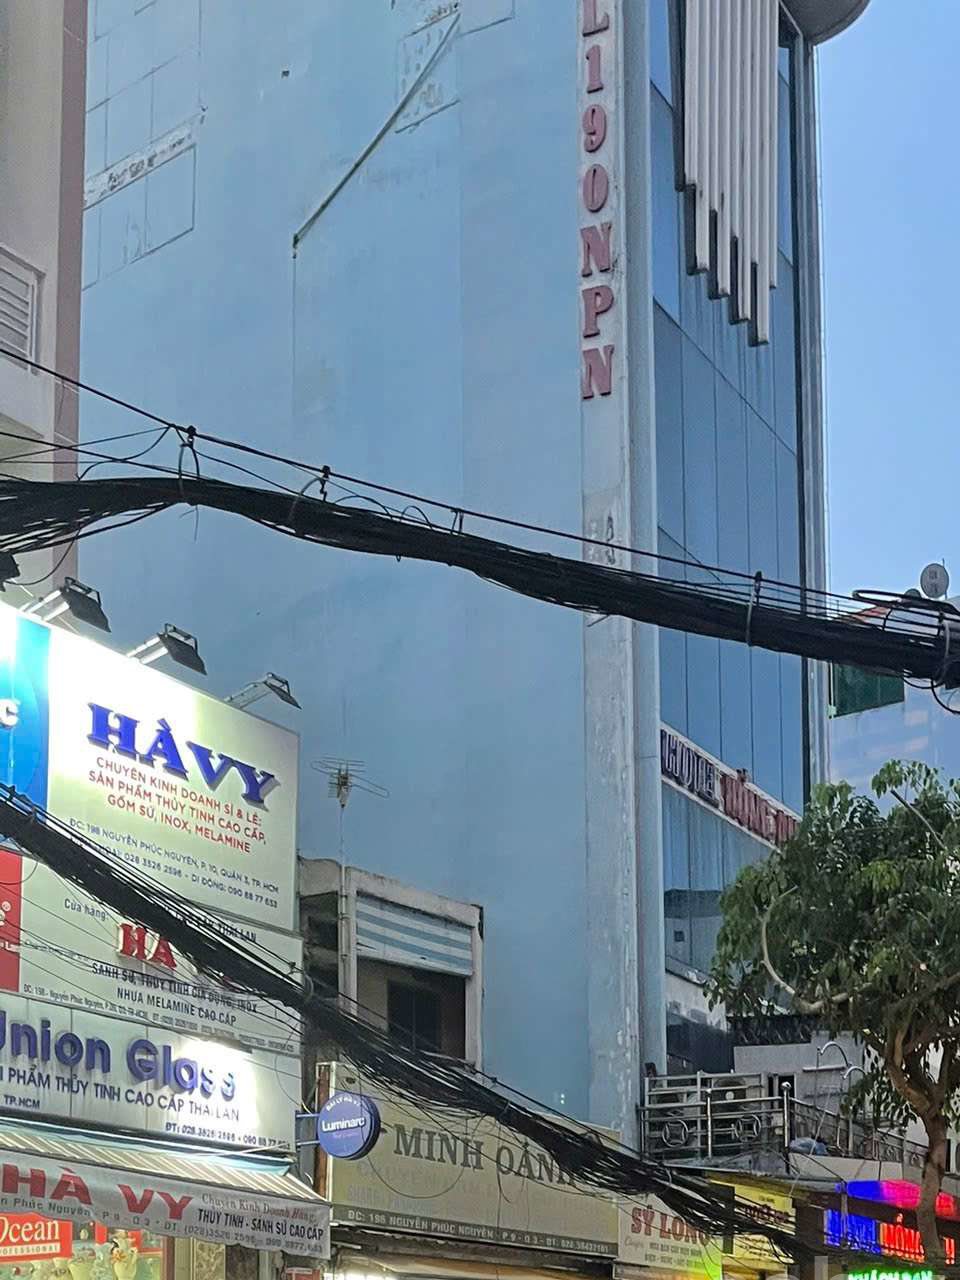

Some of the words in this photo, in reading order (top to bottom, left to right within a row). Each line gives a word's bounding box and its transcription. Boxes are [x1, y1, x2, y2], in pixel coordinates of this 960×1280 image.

[88, 769, 115, 789] SẢN
[190, 806, 215, 826] TINH
[218, 817, 241, 834] CAO
[96, 756, 146, 784] CHUYÊN
[150, 778, 178, 796] KINH
[181, 787, 221, 811] DOANH
[236, 808, 243, 819] &
[107, 794, 136, 813] GỐM
[161, 813, 192, 835] INOX,
[195, 825, 251, 853] MELAMINE
[147, 994, 195, 1016] MELAMINE
[8, 1063, 50, 1090] PHẨM
[55, 1073, 89, 1097] THỦY
[93, 1082, 121, 1101] TINH
[125, 1089, 155, 1107] CAO
[322, 1117, 365, 1132] Luminarc
[393, 1123, 485, 1171] MINH
[2, 1163, 93, 1206] HÀ
[117, 1183, 193, 1221] VY
[224, 1213, 244, 1229] TINH
[289, 1225, 305, 1240] CAO
